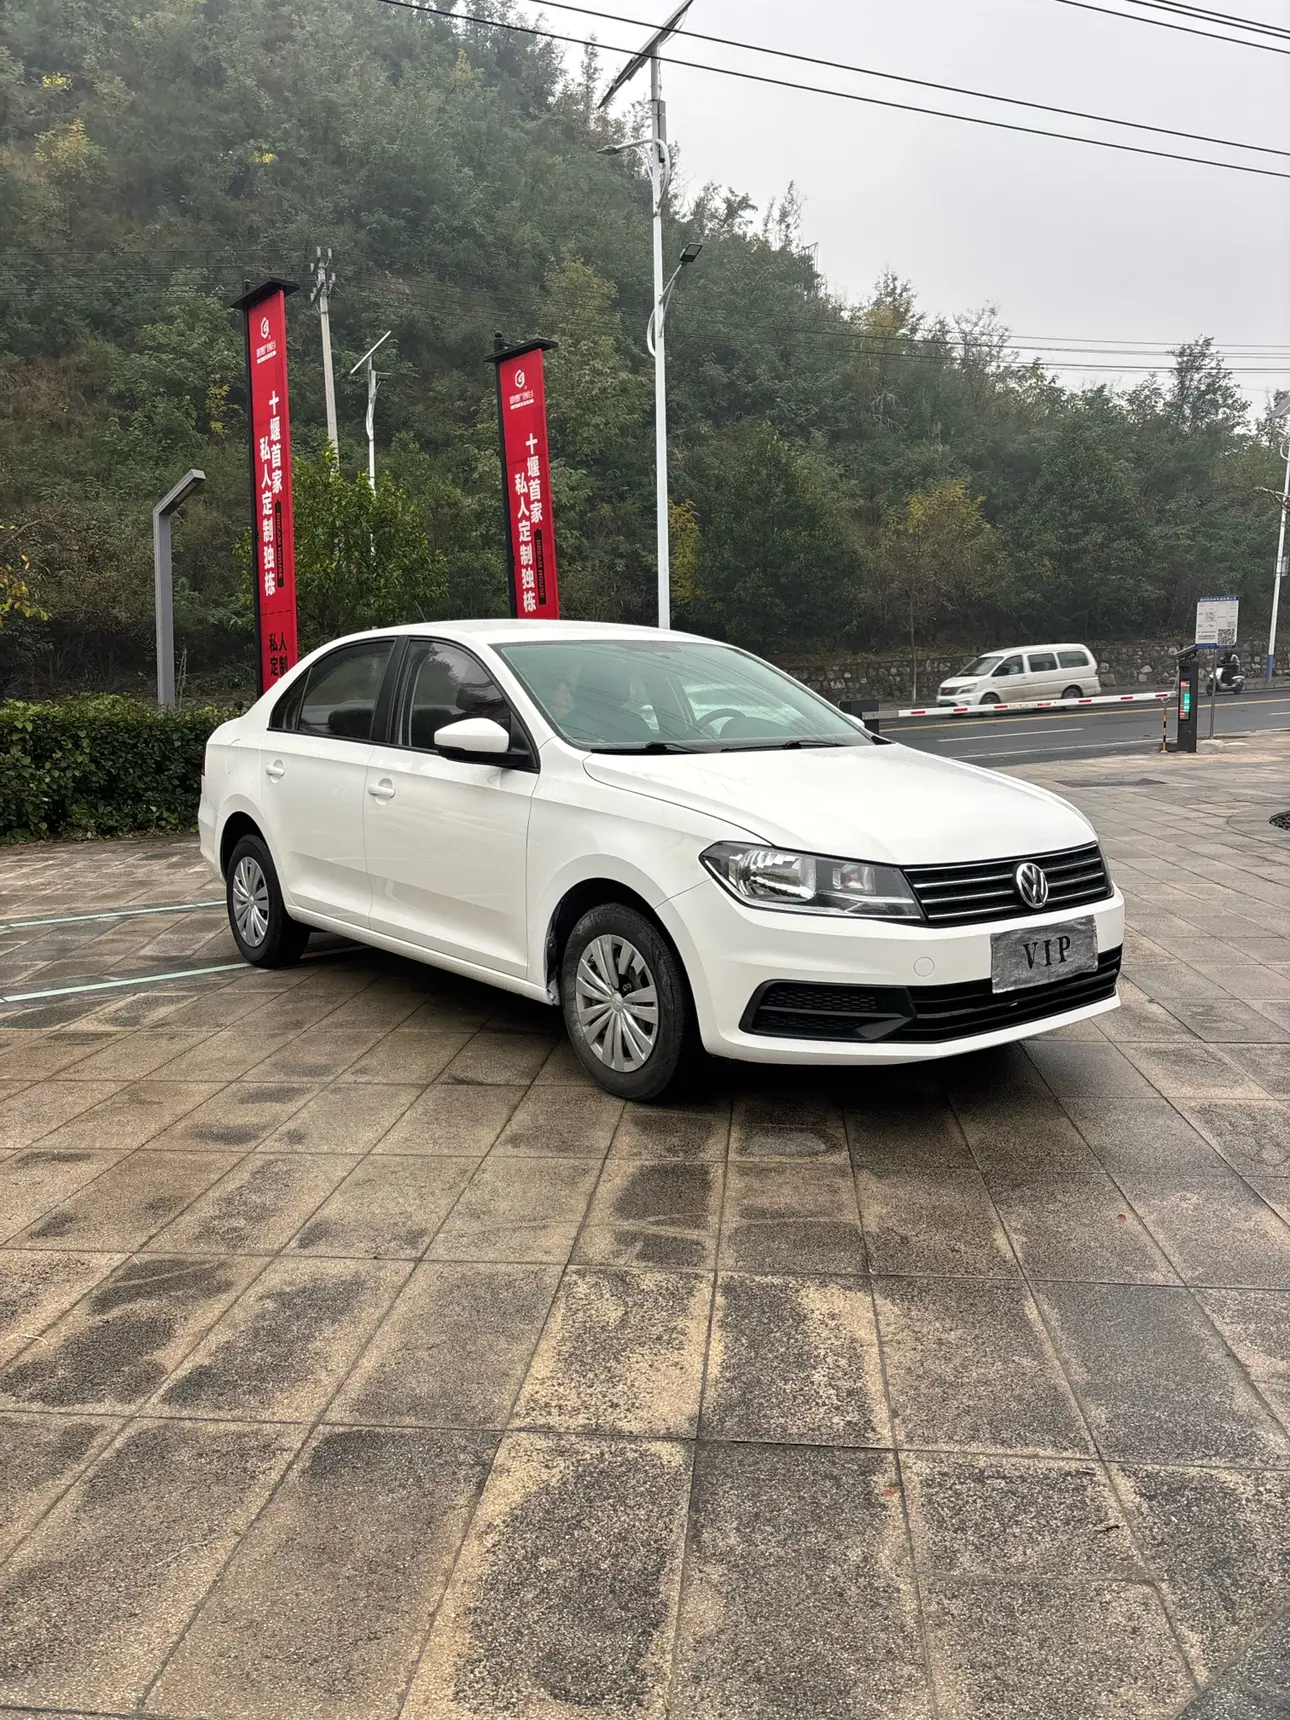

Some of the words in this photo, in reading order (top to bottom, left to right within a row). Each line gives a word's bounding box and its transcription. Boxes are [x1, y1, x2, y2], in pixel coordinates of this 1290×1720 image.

[269, 391, 282, 494] 十堰首家
[526, 434, 543, 523] 十堰首家
[260, 436, 276, 596] 私人定制独栋
[515, 473, 536, 613] 私人定制独栋
[1022, 935, 1071, 970] VIP
